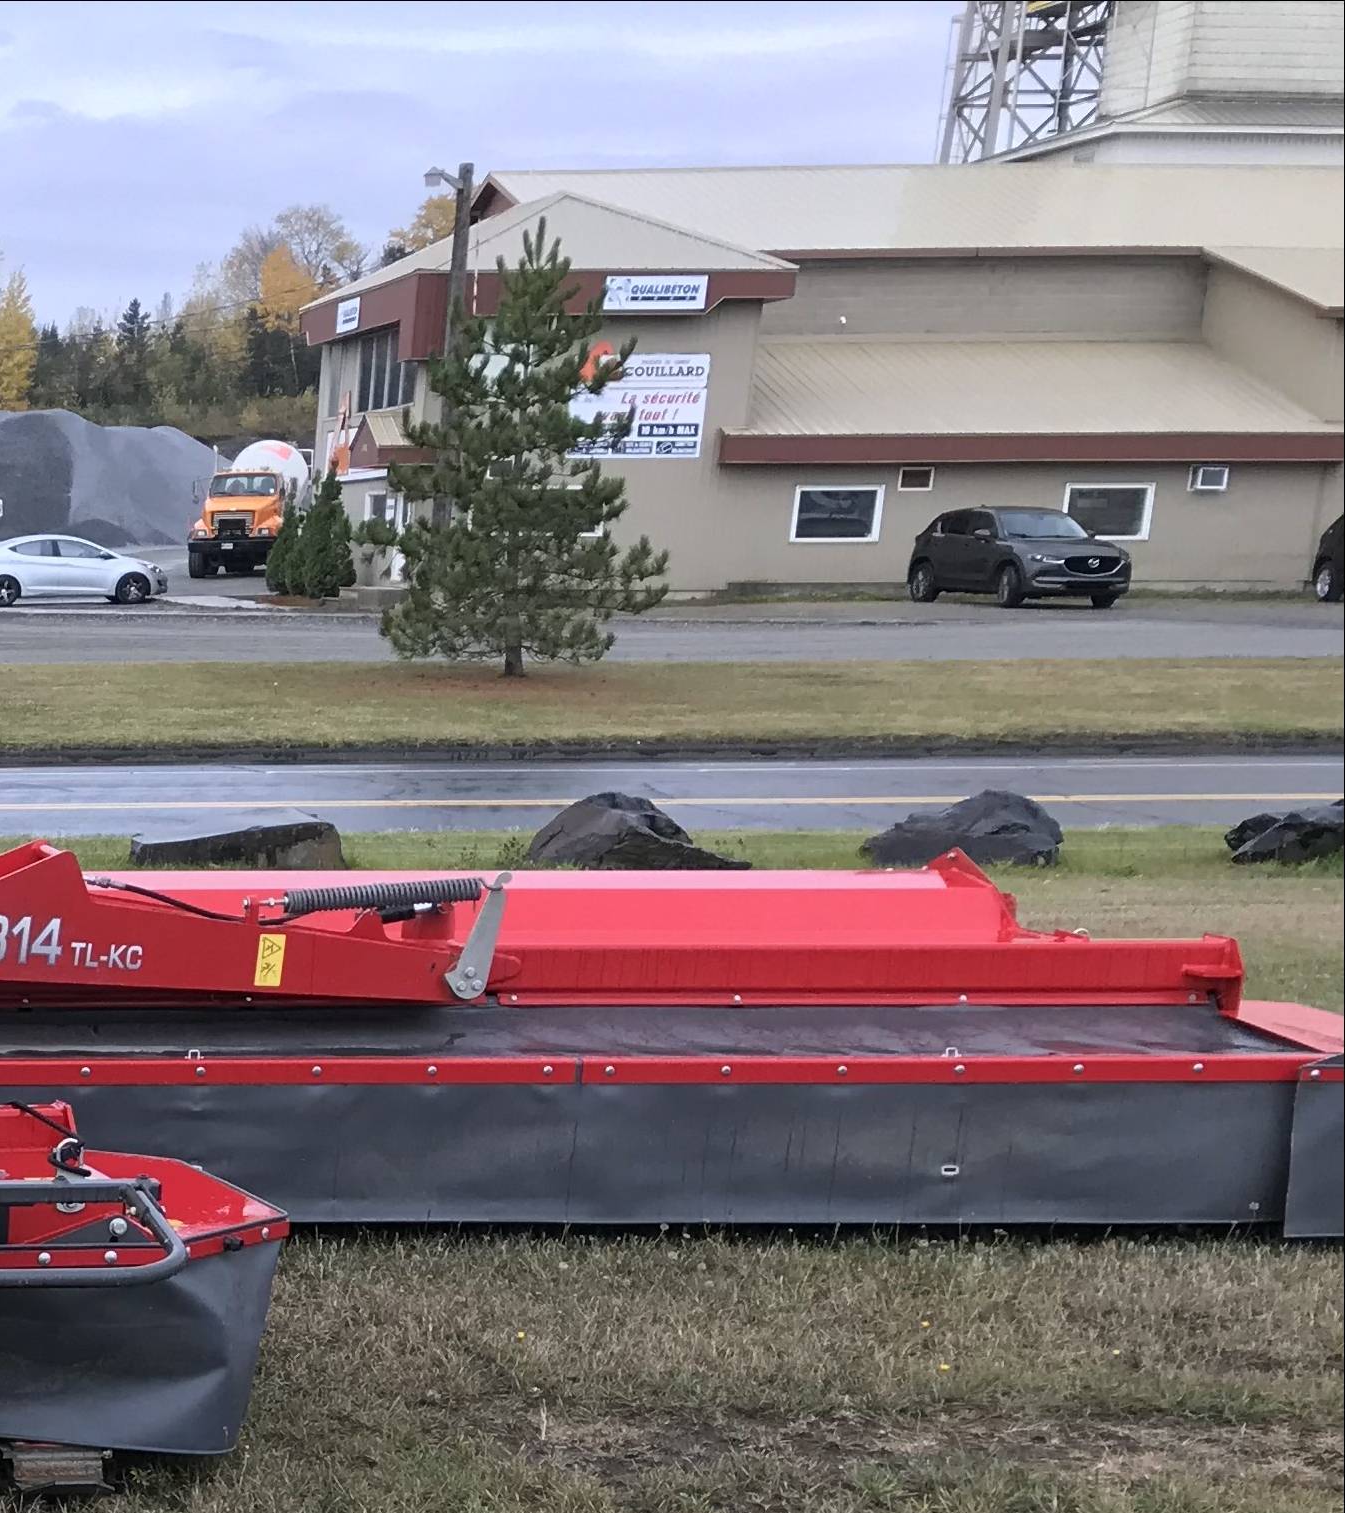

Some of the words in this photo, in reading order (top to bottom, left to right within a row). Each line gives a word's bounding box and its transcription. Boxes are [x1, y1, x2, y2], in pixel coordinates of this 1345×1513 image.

[623, 366, 705, 376] COUILLARD
[621, 392, 637, 404] La
[642, 391, 701, 404] sécurité
[639, 408, 668, 420] tout
[70, 941, 143, 970] TL-KC
